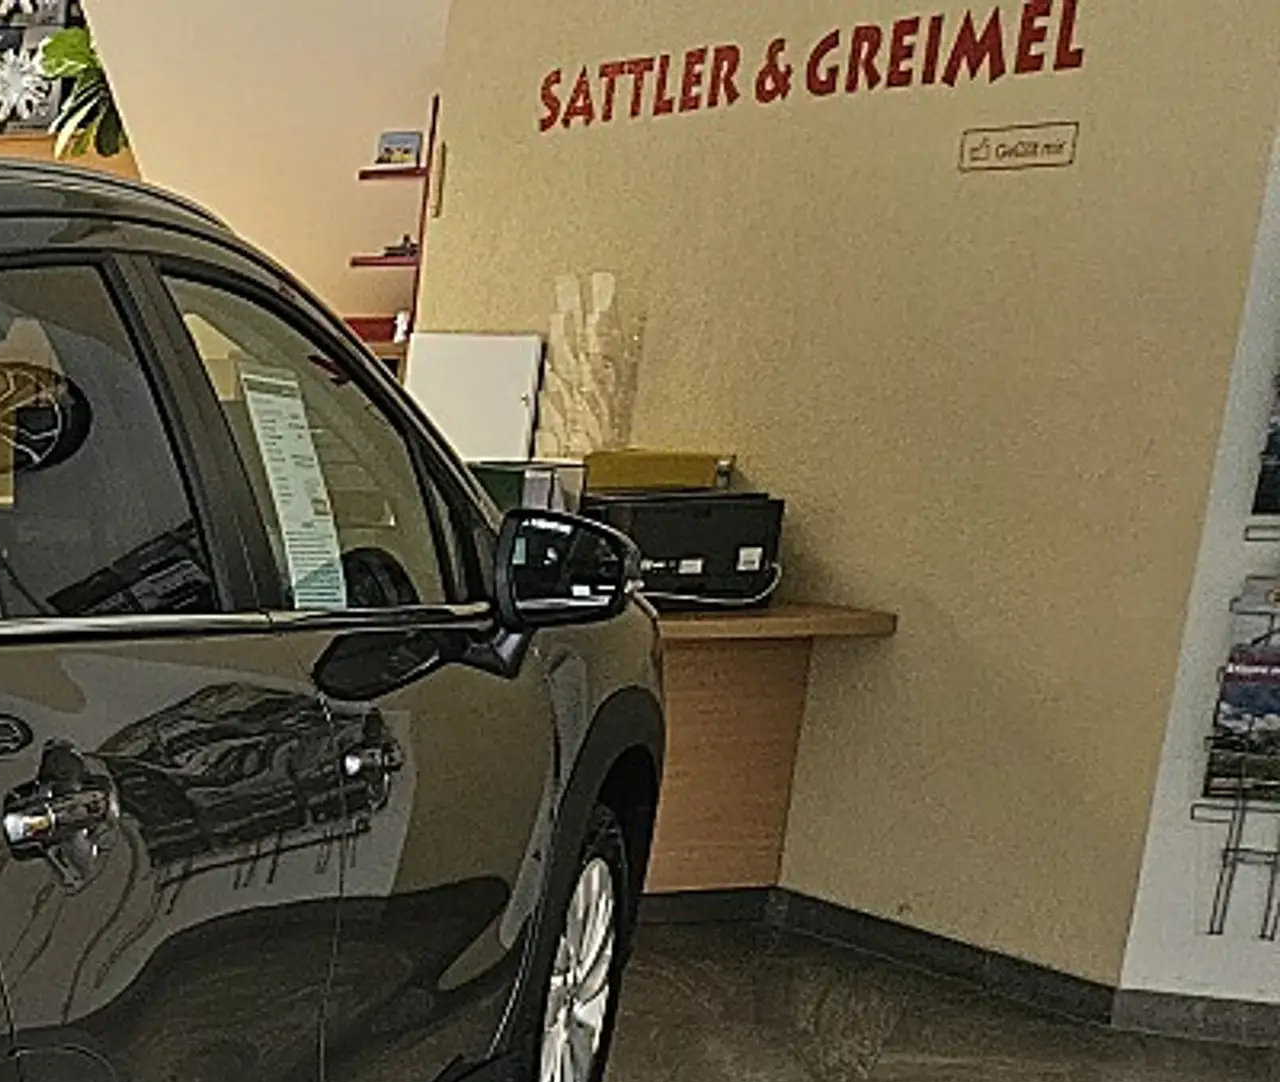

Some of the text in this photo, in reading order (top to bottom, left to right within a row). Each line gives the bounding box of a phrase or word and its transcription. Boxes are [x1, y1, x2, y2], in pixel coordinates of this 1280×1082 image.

[539, 0, 1083, 132] SATTLER & GREIMEL
